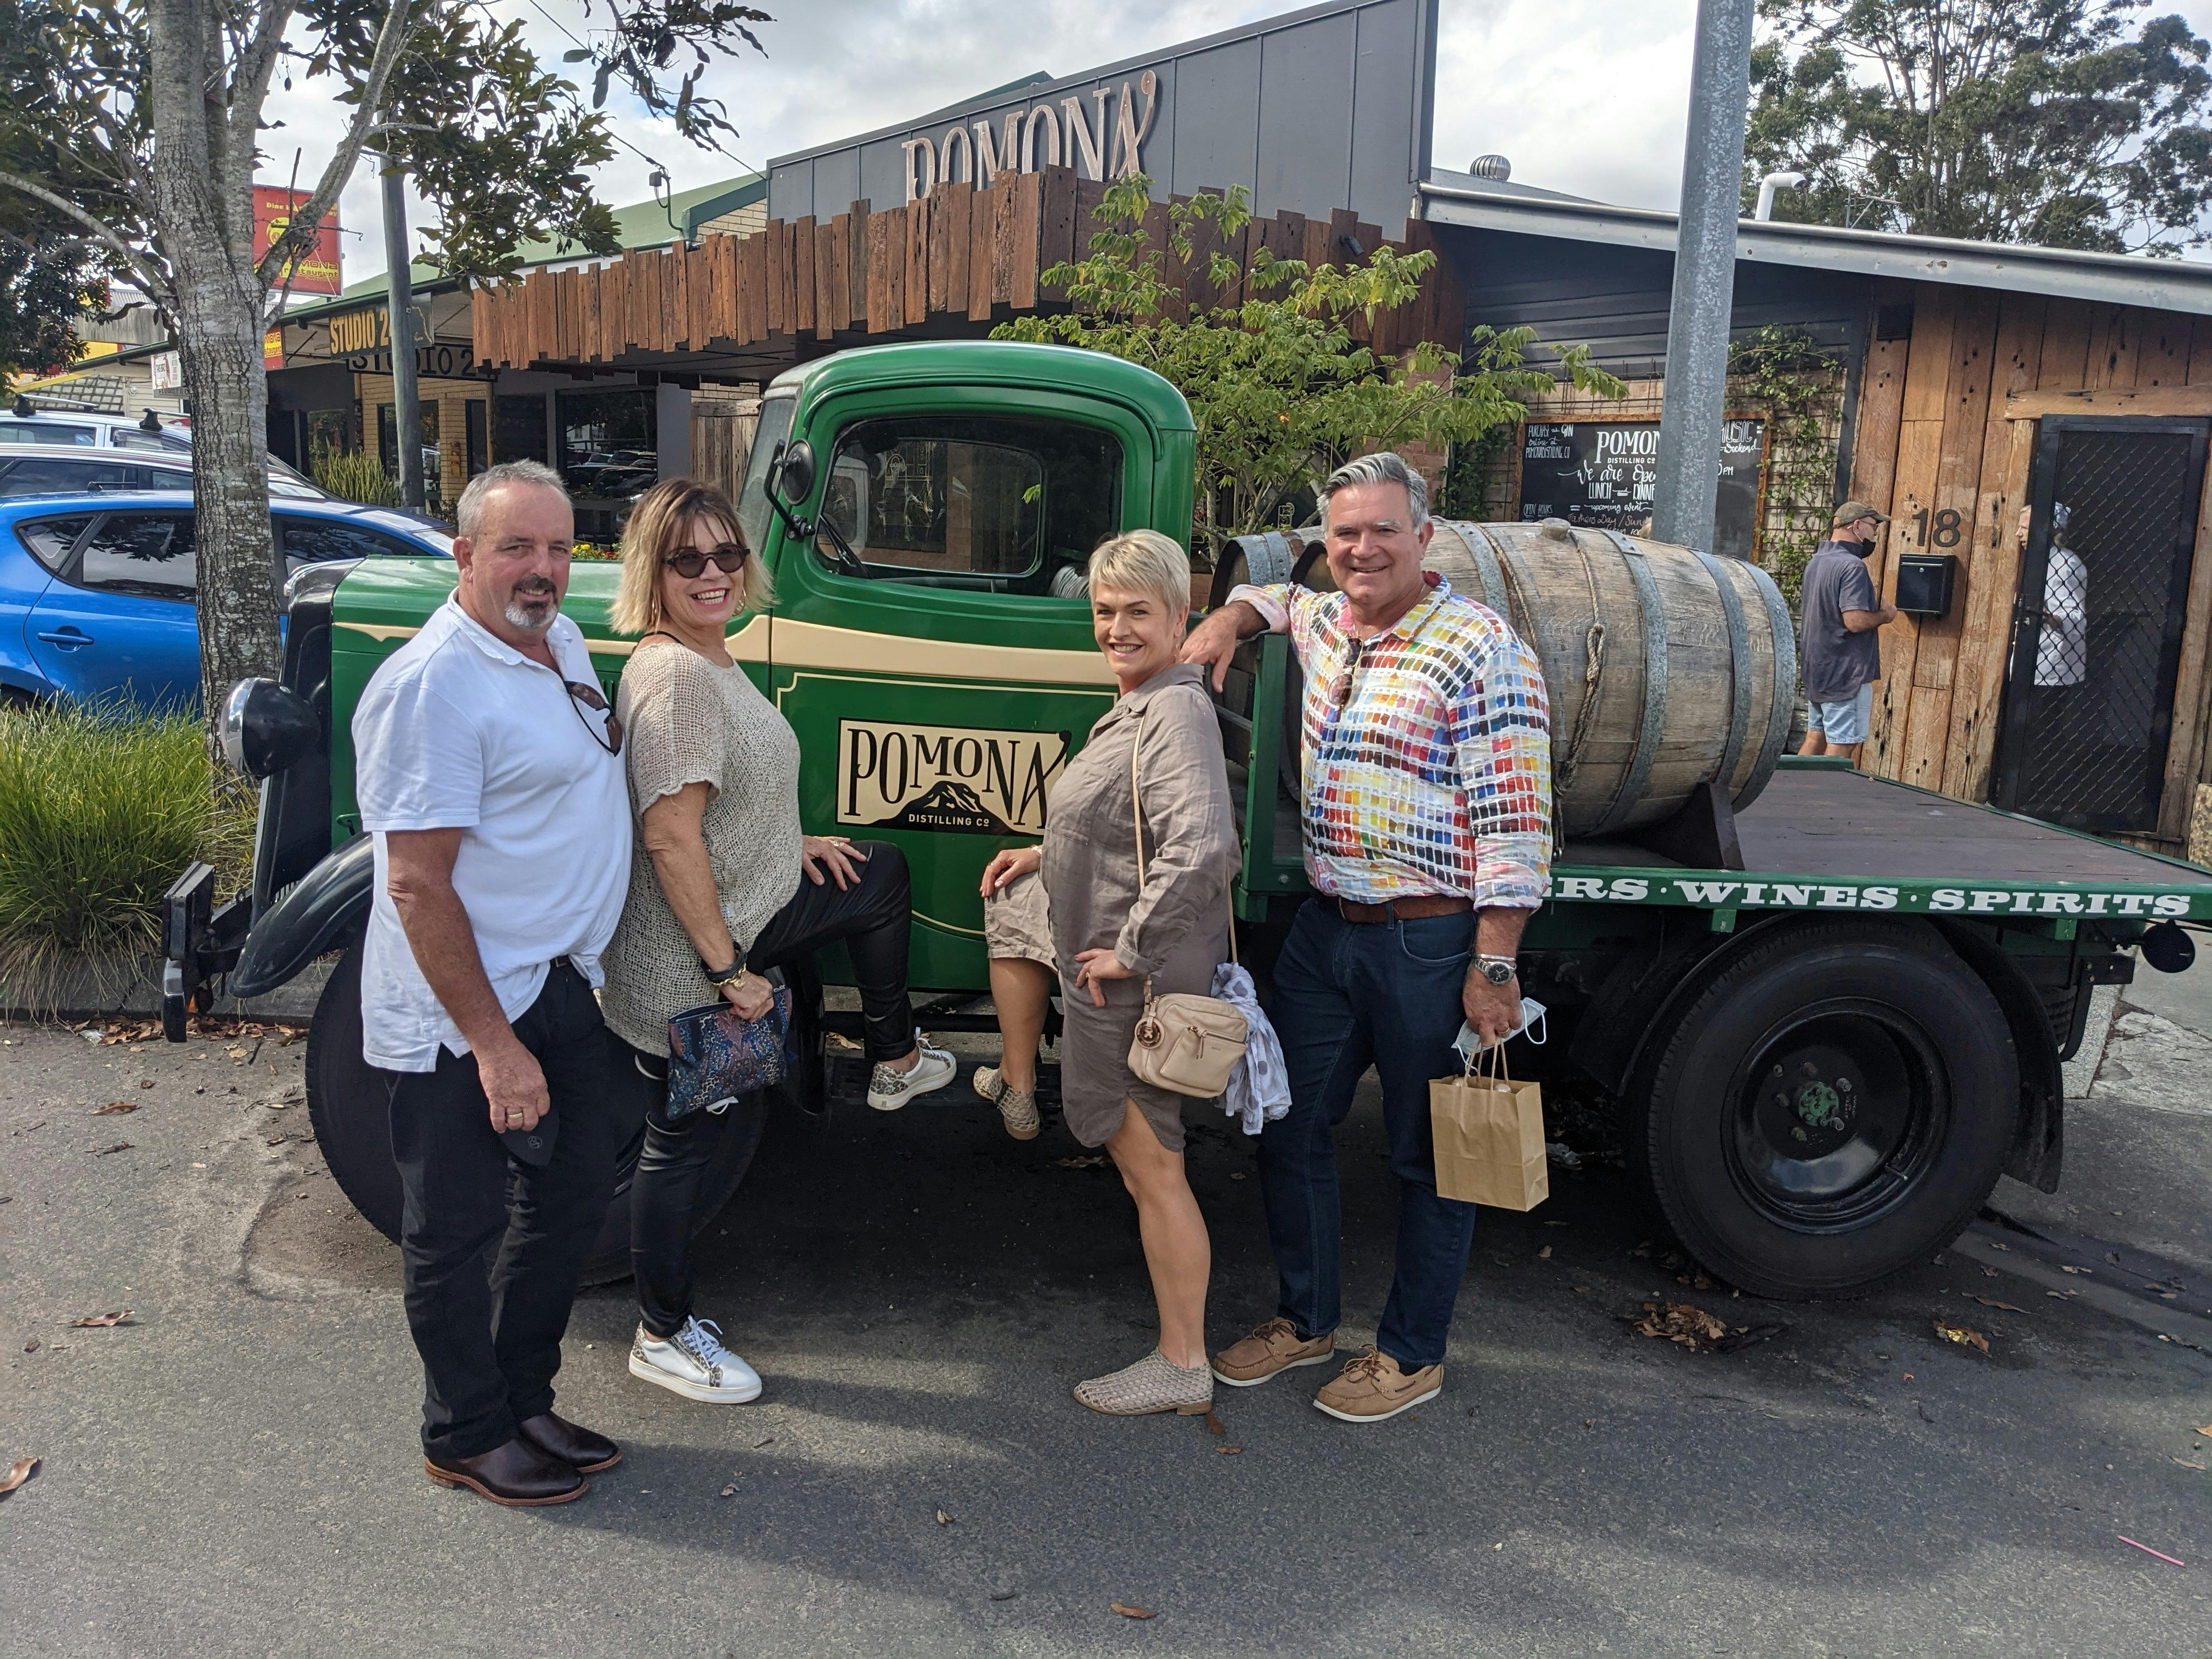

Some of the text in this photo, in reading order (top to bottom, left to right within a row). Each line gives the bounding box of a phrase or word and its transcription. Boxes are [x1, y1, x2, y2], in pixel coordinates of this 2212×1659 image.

[901, 70, 1156, 207] POMONA
[284, 268, 338, 278] rstaurant
[330, 307, 392, 354] STUDIO 2
[1561, 424, 1574, 438] GIN
[1600, 464, 1624, 481] are
[1588, 482, 1612, 499] LUNCH
[1912, 508, 1961, 547] 18
[844, 729, 1072, 829] POMONA
[909, 814, 972, 826] DISTILLING
[1673, 880, 1899, 909] WINES
[1928, 889, 2191, 916] SPIRITS
